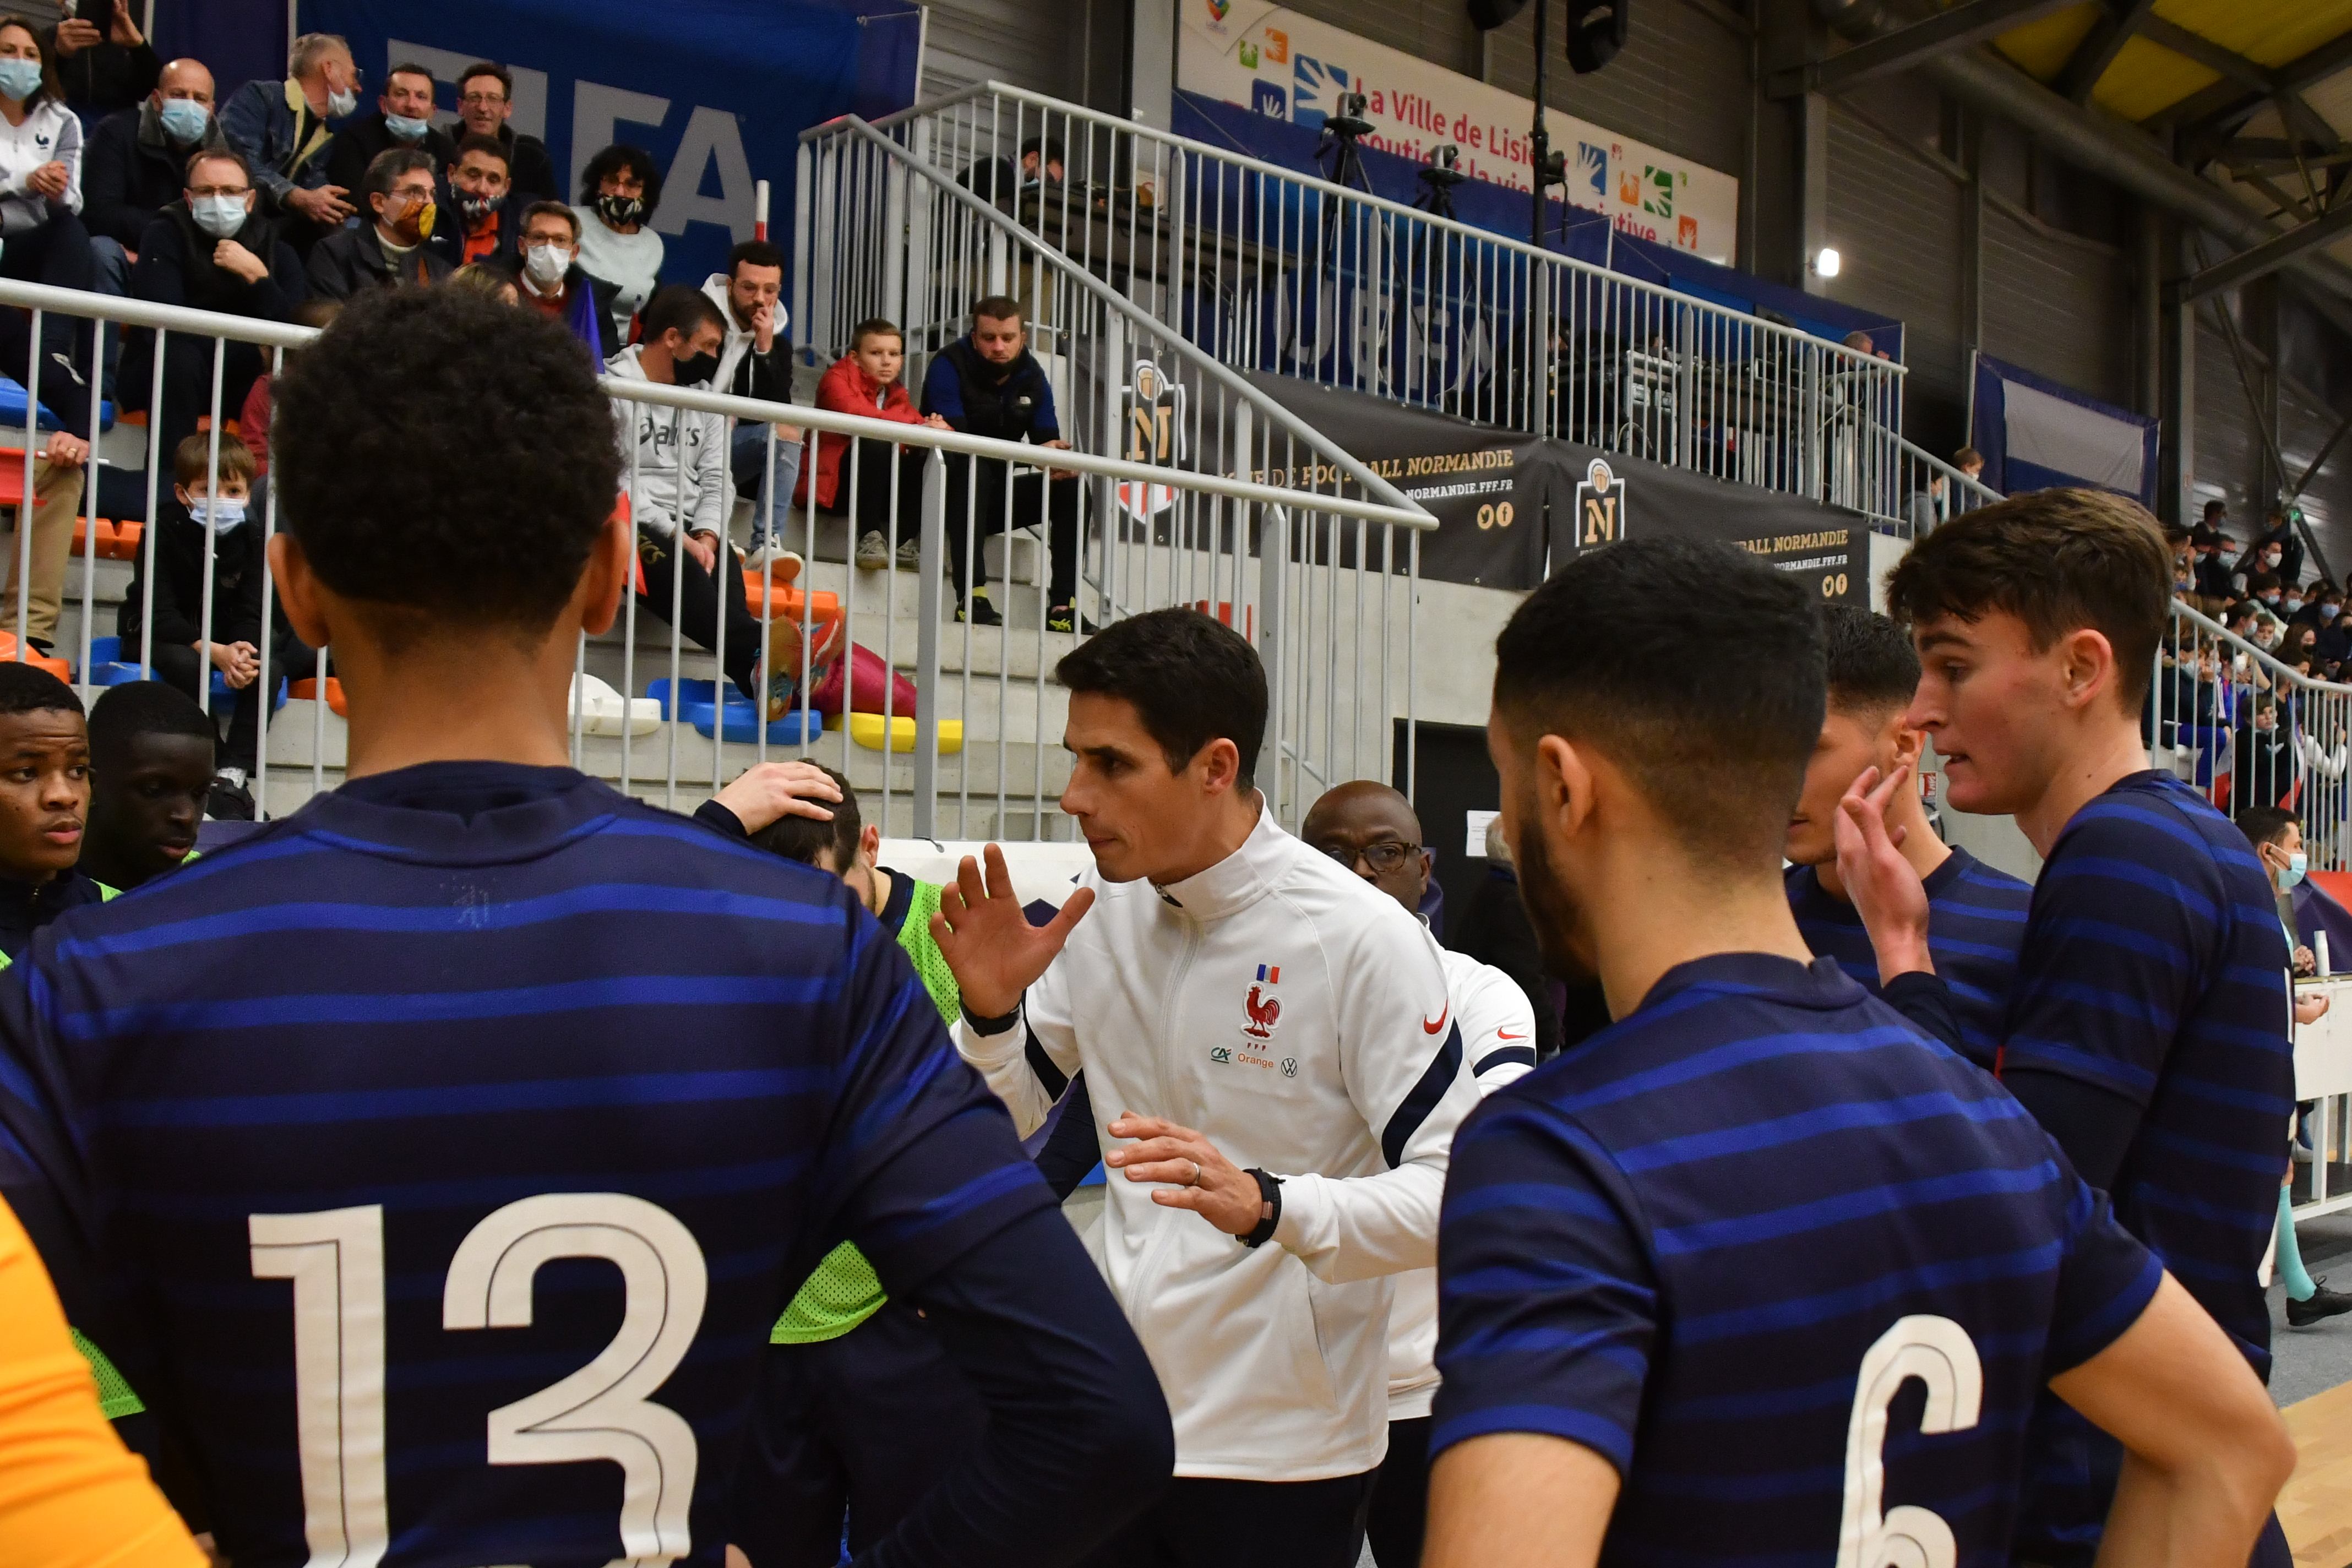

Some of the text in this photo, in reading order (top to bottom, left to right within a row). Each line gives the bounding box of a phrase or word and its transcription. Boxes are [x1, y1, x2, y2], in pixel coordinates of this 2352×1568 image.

[1392, 88, 1446, 135] Ville
[1453, 113, 1482, 149] de
[1406, 449, 1514, 476] NORMANDIE
[1773, 529, 1849, 553] NORMANDIE
[1238, 1053, 1274, 1069] Orange
[248, 1192, 708, 1568] 13
[1836, 1314, 1984, 1568] 6
